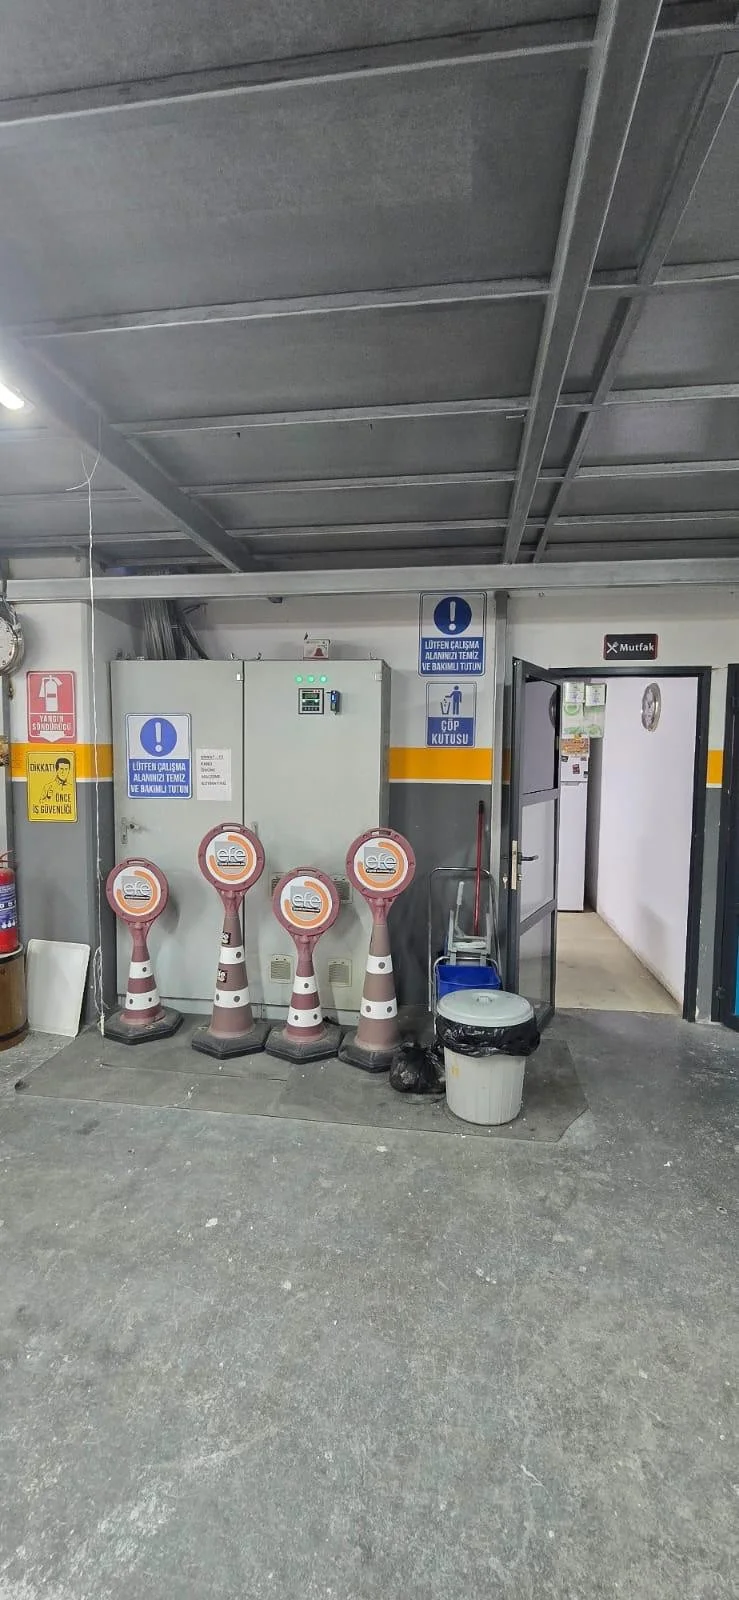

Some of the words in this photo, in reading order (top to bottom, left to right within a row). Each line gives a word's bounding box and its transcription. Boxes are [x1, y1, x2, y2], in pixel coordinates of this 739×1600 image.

[425, 640, 449, 649] LÜTFEN
[451, 640, 479, 650] ÇALIŞMA
[620, 642, 654, 652] Mutfak
[425, 651, 457, 660] ALANINIZI
[458, 650, 479, 660] TEMİZ
[422, 662, 431, 671] VE
[432, 662, 458, 671] BAKIMLI
[460, 662, 481, 671] TUTUN
[39, 715, 64, 723] YANGIN
[441, 718, 460, 733] ÇÖP
[431, 733, 468, 745] KUTUSU
[132, 761, 157, 771] LÜTFEN
[157, 762, 186, 772] ÇALIŞMA
[166, 773, 186, 783] TEMİZ
[130, 784, 139, 793] VE
[168, 784, 189, 794] TUTUN
[56, 792, 72, 803] ÖNCE
[216, 846, 246, 862] efe
[366, 853, 397, 869] efe
[123, 881, 152, 895] efe
[292, 891, 322, 908] efe
